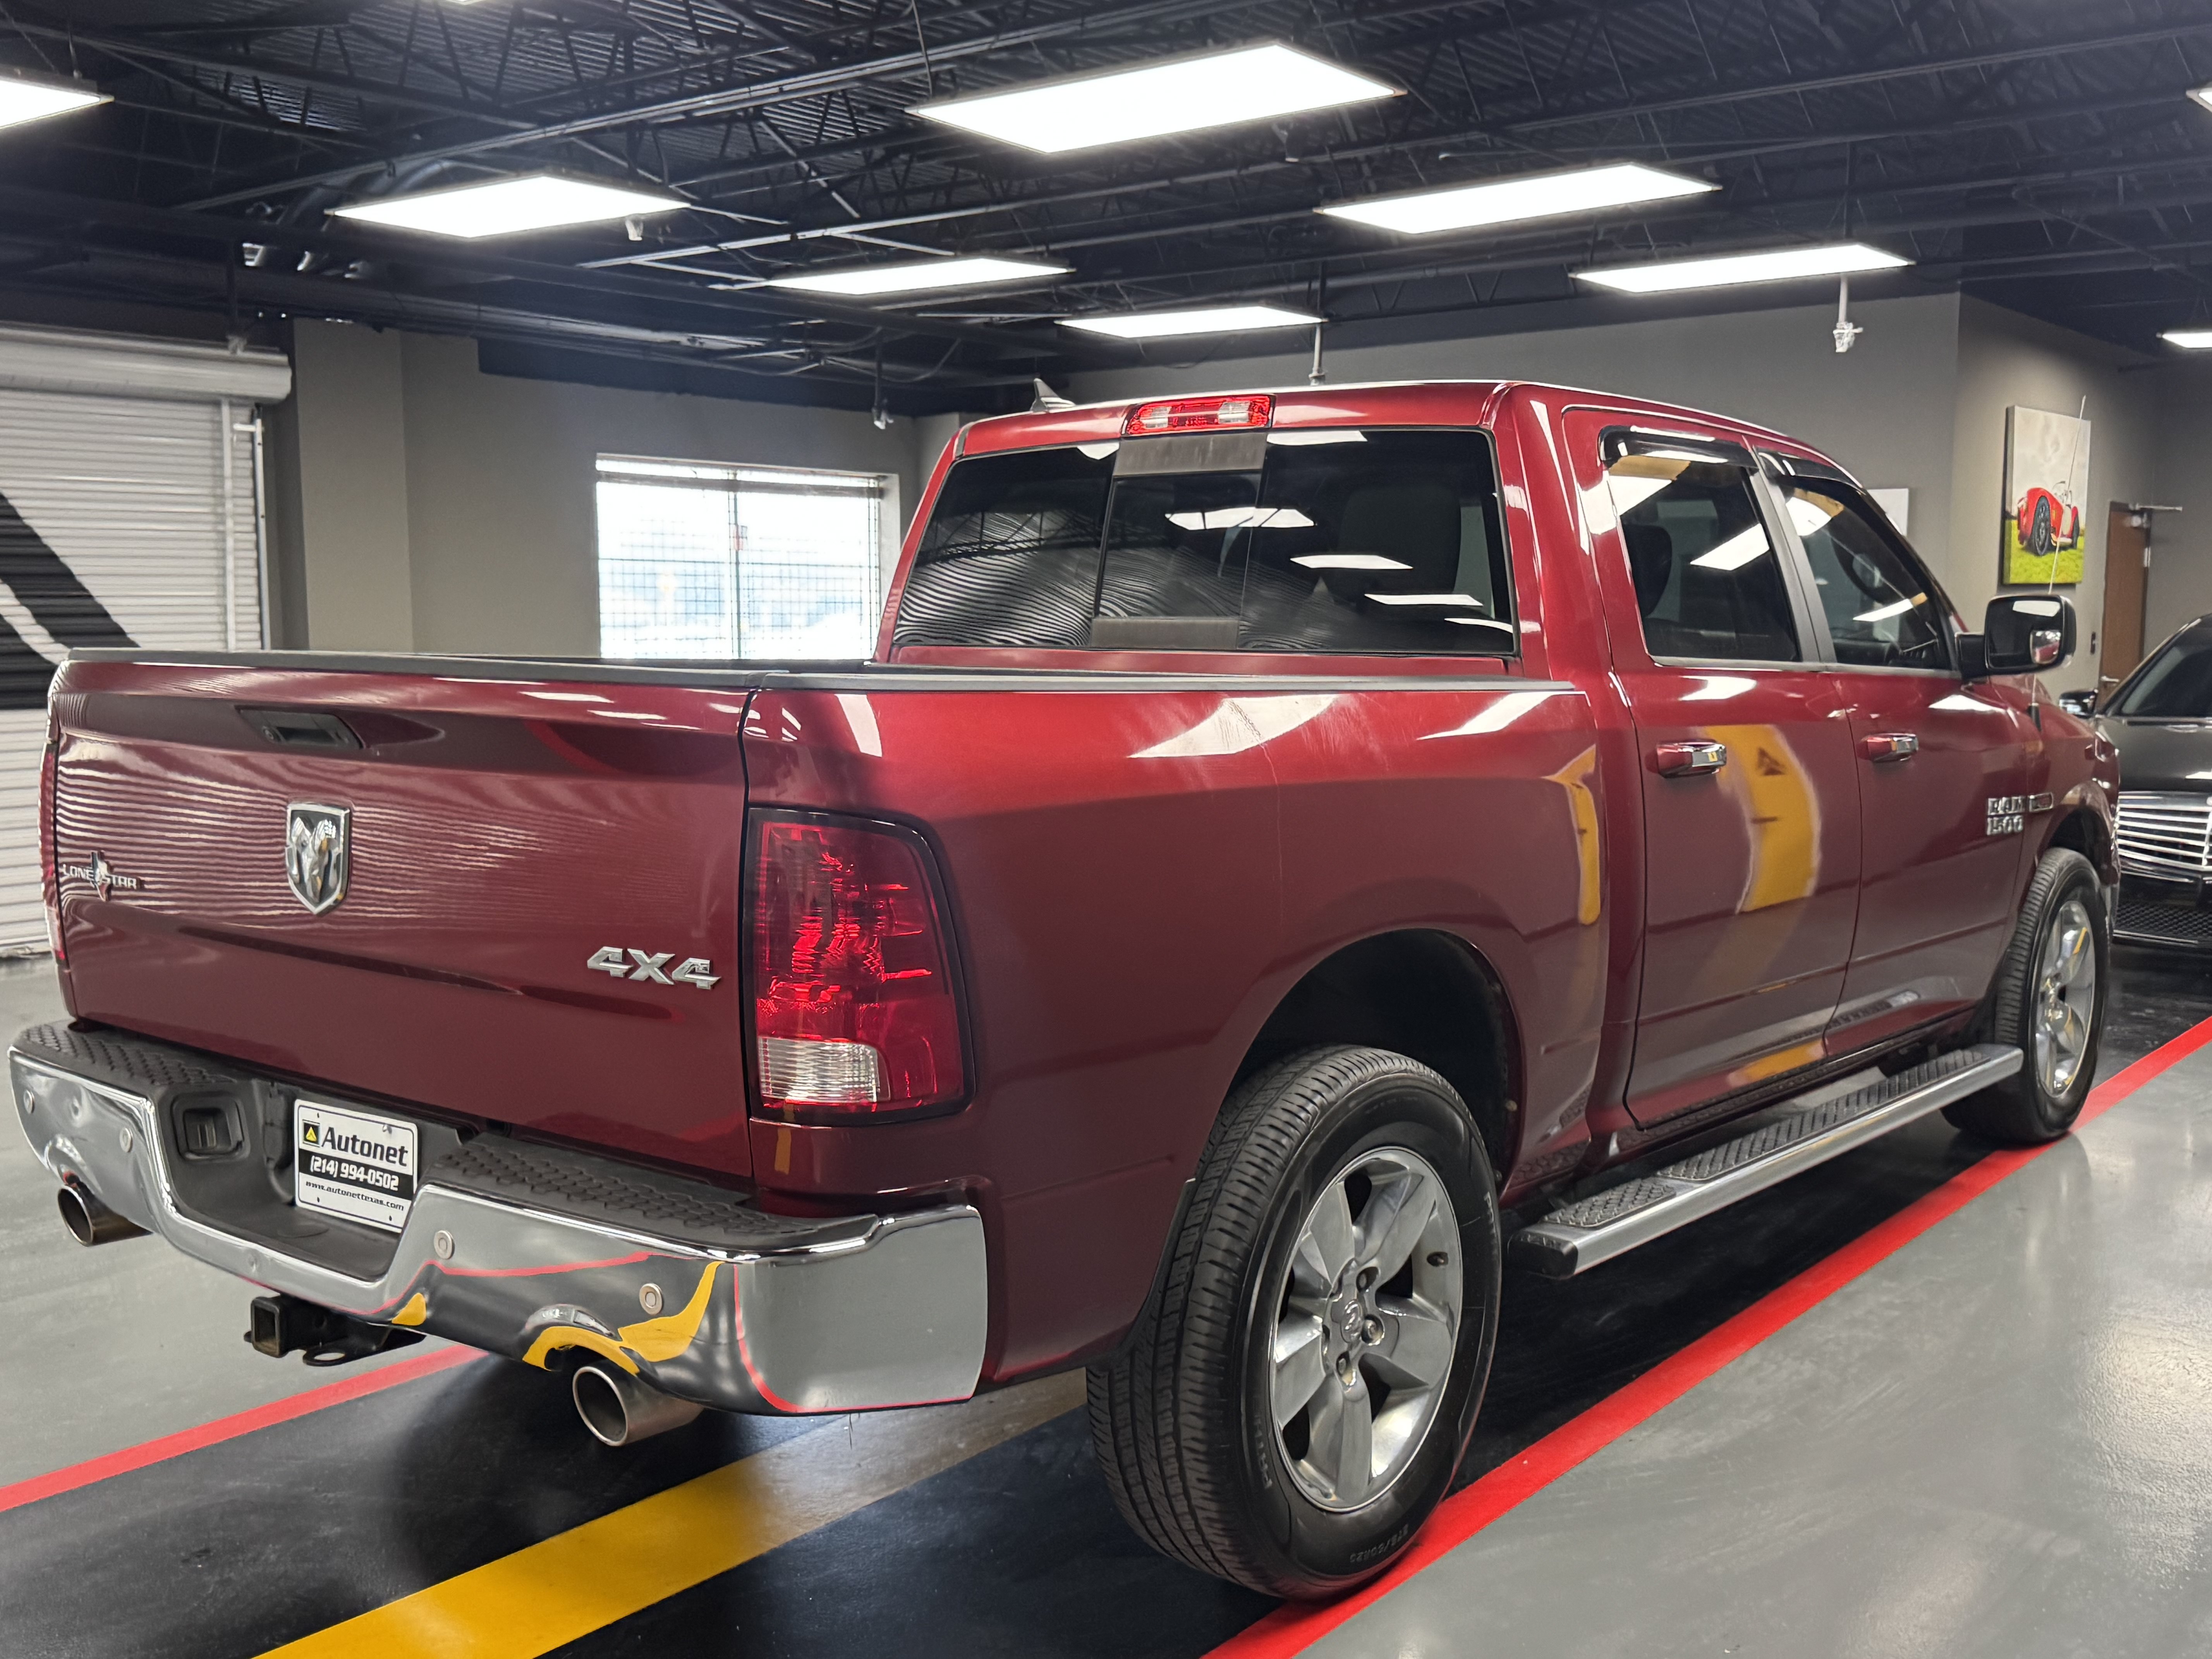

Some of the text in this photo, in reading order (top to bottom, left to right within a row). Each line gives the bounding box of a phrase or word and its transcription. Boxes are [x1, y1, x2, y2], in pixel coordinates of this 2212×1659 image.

[1987, 815, 2023, 836] 1500
[62, 864, 137, 890] LONE STAR
[321, 1127, 409, 1167] Autonet
[310, 1155, 399, 1191] (214) 994-0502
[306, 1181, 404, 1211] www.autonettexas.com
